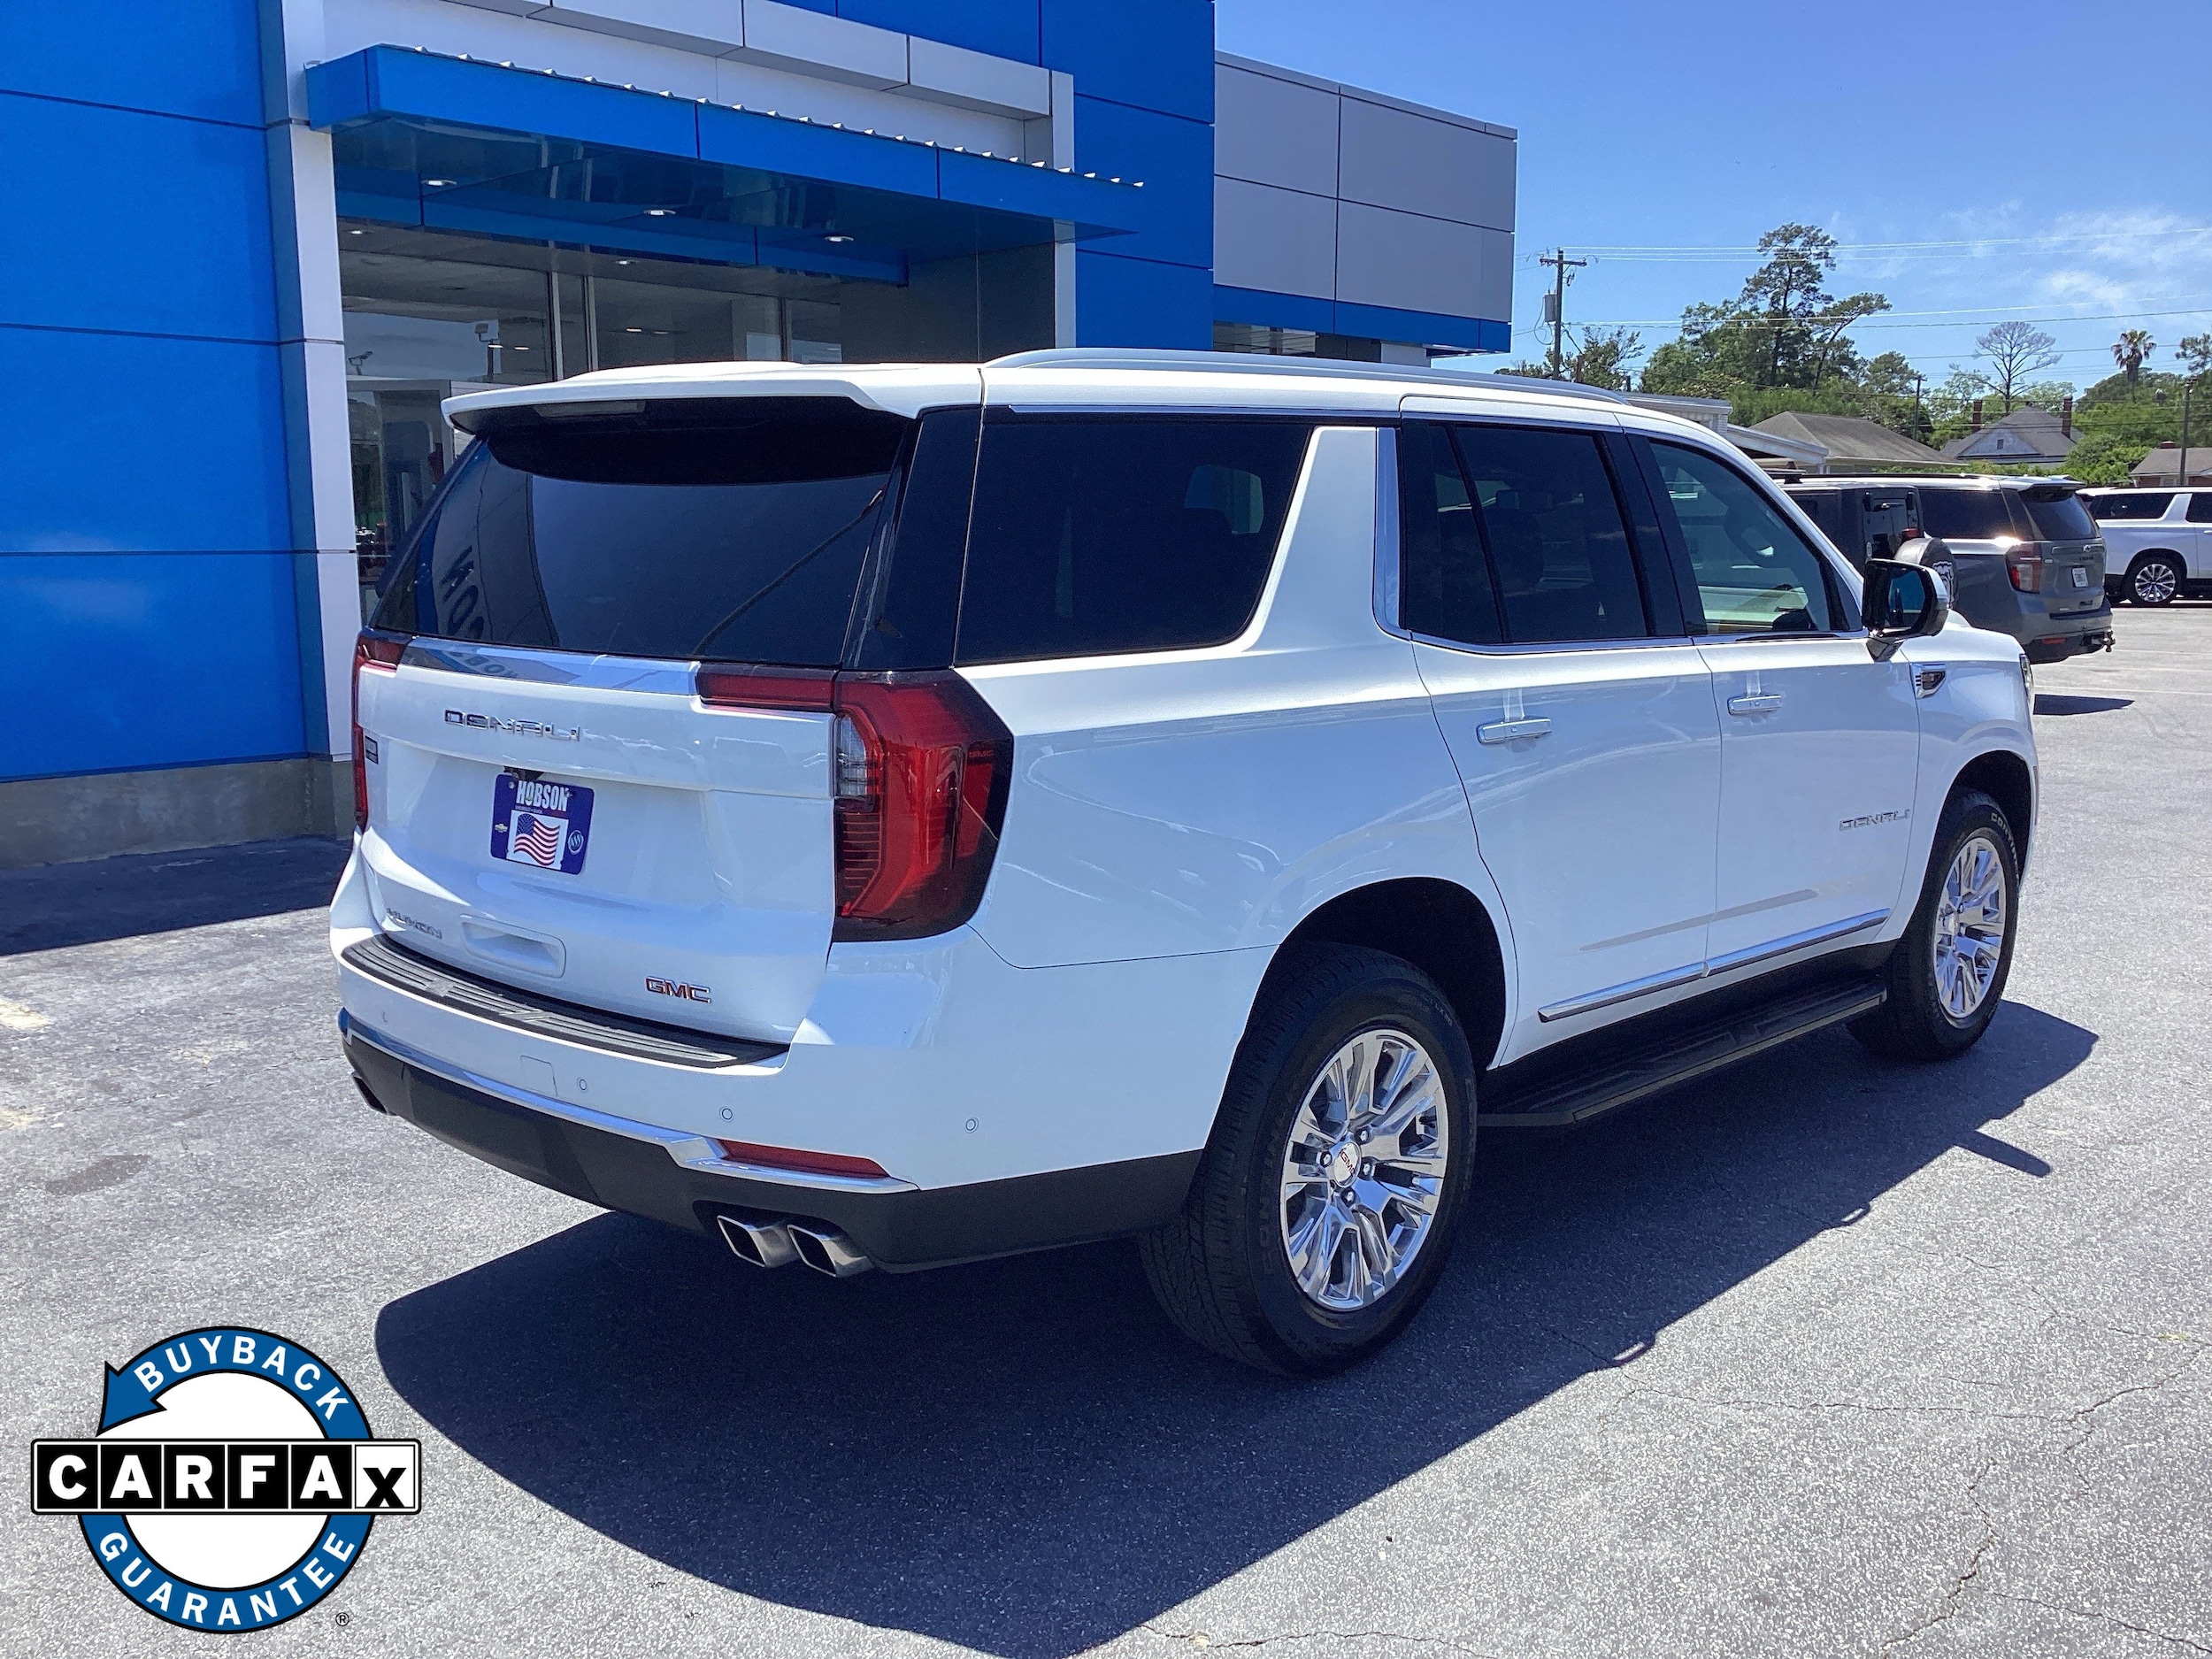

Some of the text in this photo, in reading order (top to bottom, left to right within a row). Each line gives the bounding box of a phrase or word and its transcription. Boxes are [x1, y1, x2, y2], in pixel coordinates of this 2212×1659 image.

[444, 709, 581, 742] DENALI
[516, 780, 569, 812] HOBSON
[1839, 809, 1910, 832] DENALI
[645, 976, 711, 1003] GMC
